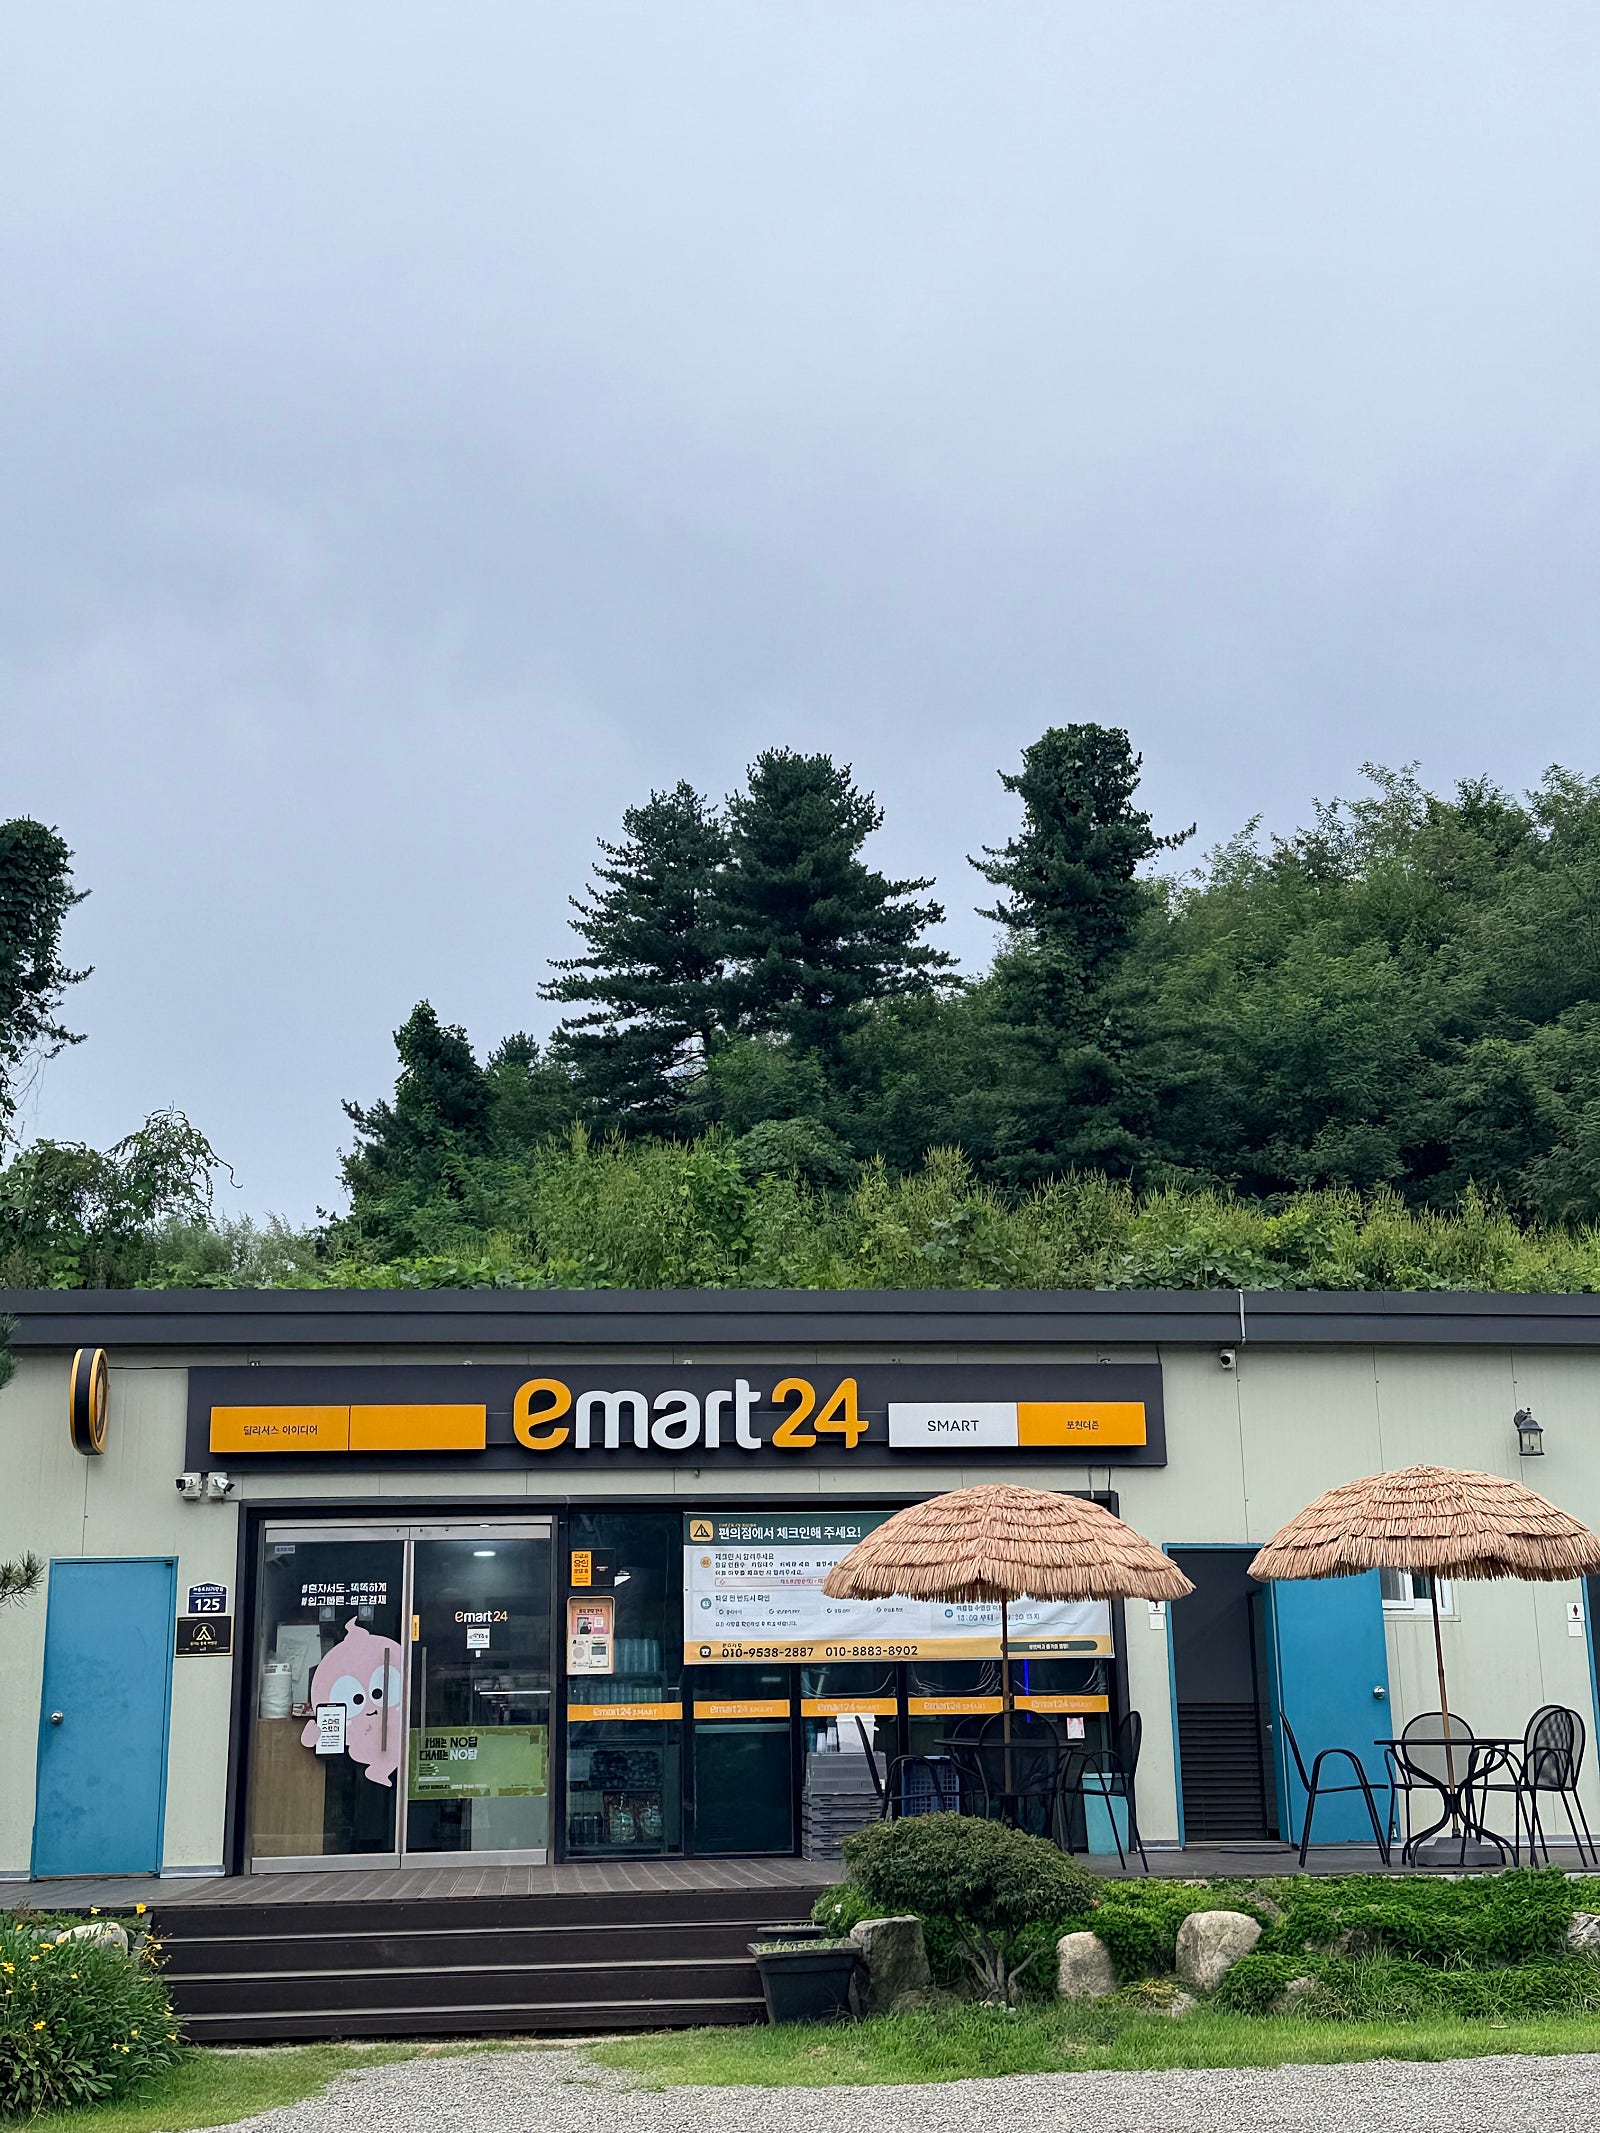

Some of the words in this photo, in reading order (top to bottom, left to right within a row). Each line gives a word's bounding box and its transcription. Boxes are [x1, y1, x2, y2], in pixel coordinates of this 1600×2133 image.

[513, 1377, 870, 1450] emart24
[927, 1419, 980, 1432] SMART
[718, 1526, 774, 1540] 편의점에서
[776, 1526, 822, 1540] 체크인해
[823, 1526, 861, 1539] 주세요!
[195, 1598, 220, 1611] 125
[454, 1610, 509, 1622] emart24
[722, 1647, 814, 1658] 010-9538-2887
[825, 1646, 918, 1656] 010-8883-8902
